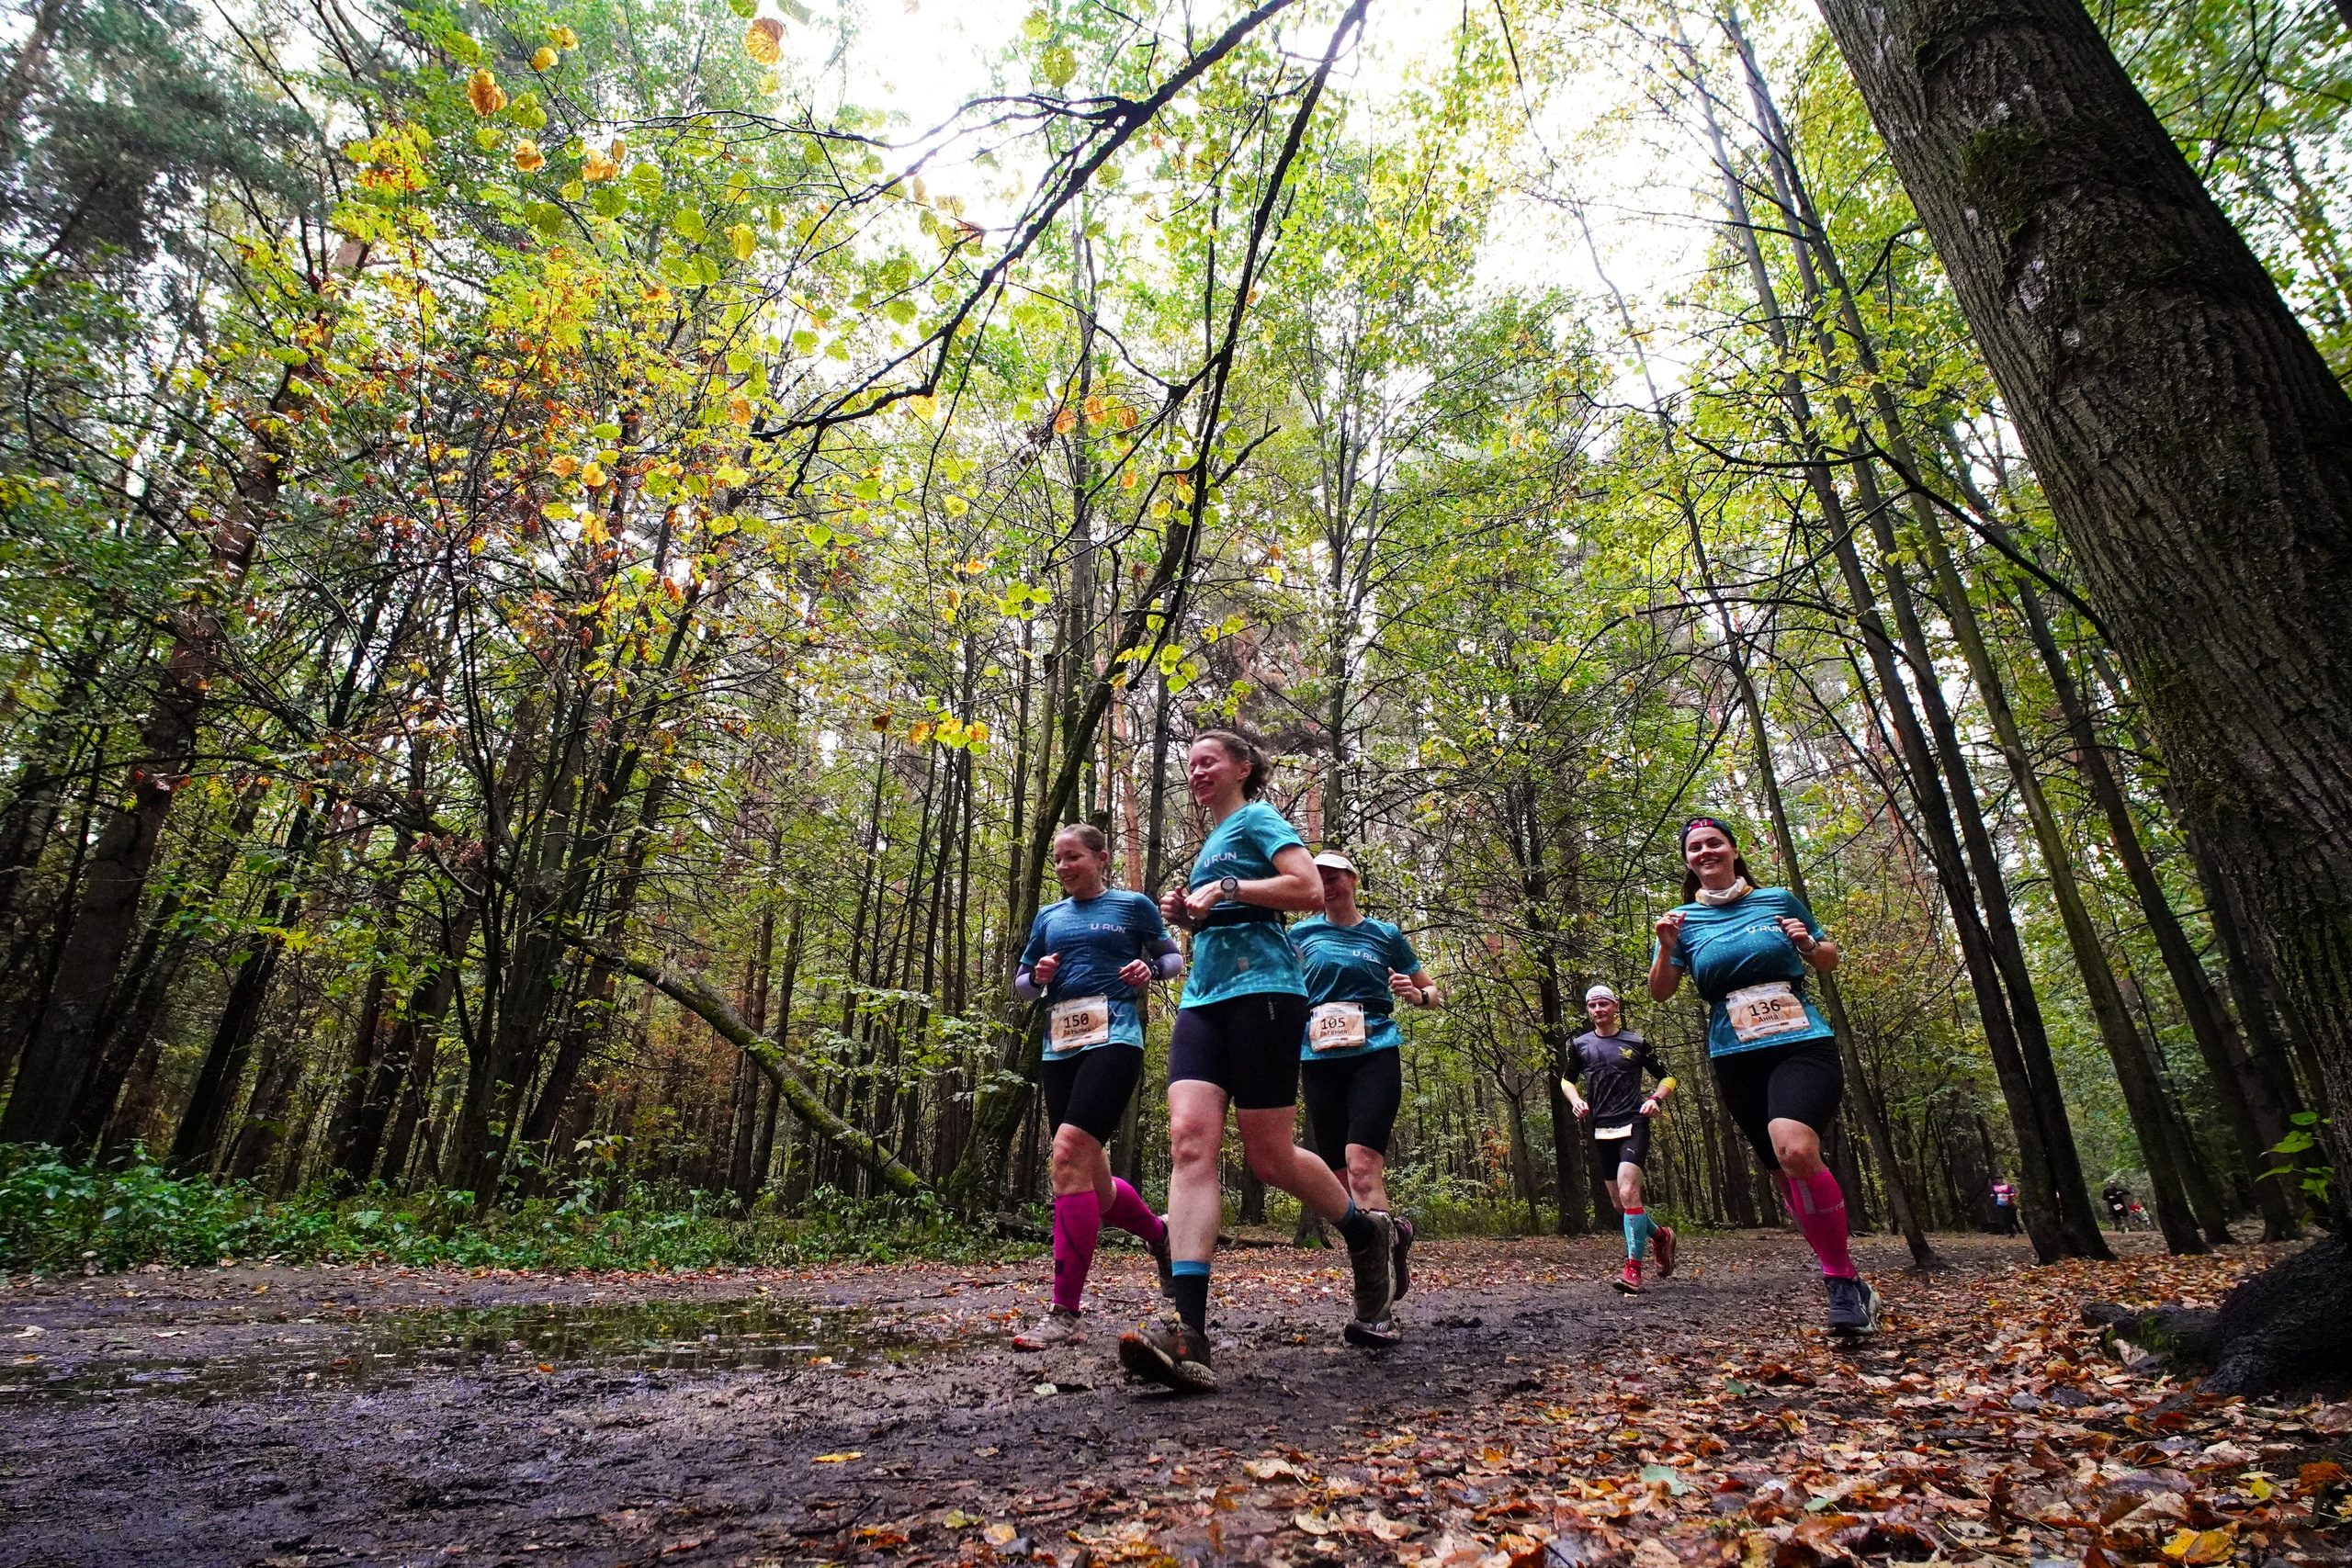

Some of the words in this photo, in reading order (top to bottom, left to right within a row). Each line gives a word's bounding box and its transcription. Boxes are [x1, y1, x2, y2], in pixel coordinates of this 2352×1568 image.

[1212, 852, 1237, 863] RUN
[1102, 923, 1125, 933] RUN
[1749, 999, 1781, 1016] 136
[1064, 1013, 1089, 1028] 150
[1320, 1017, 1346, 1030] 105
[1758, 1014, 1779, 1022] Анна
